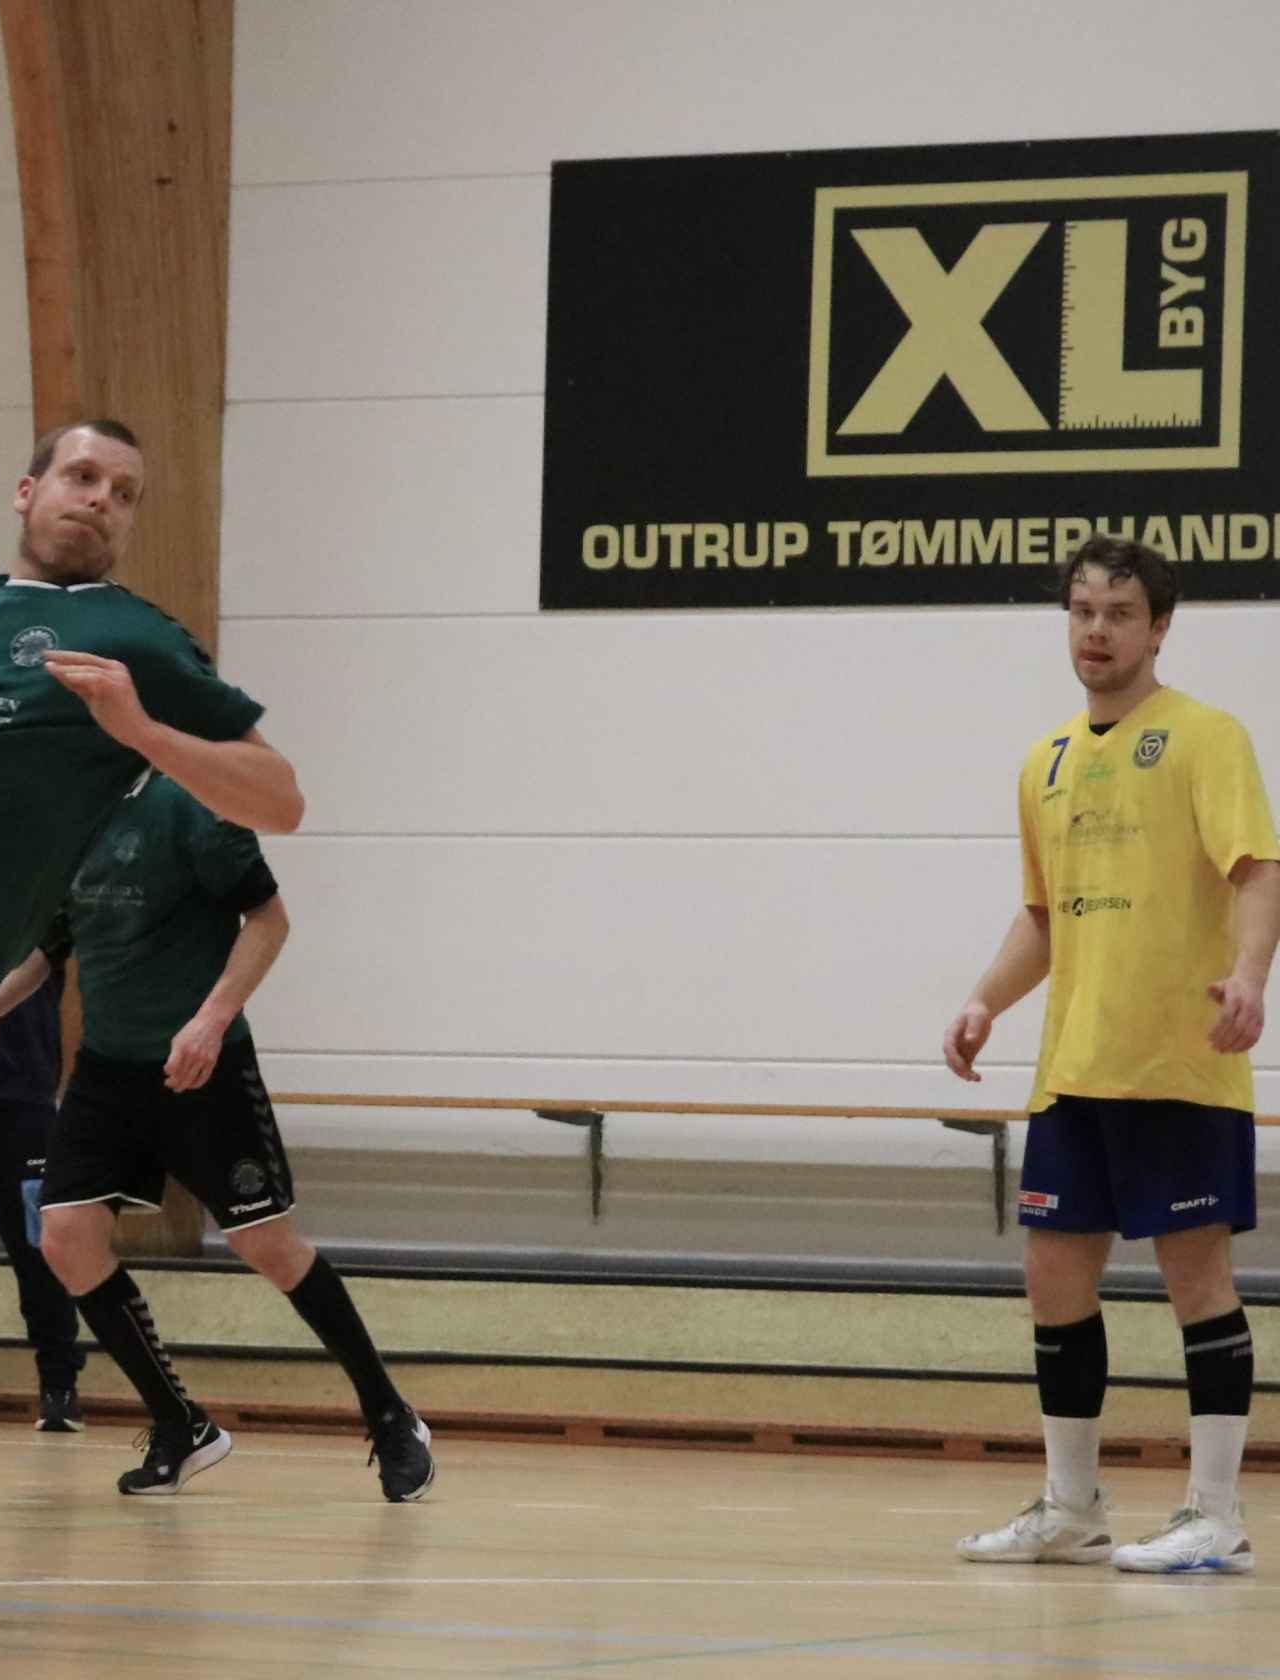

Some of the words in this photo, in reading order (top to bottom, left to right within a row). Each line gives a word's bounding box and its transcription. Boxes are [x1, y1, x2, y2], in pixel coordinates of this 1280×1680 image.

[836, 218, 1203, 436] XL
[1158, 216, 1208, 349] BYG
[582, 521, 809, 570] OUTRUP
[1048, 736, 1070, 787] 7
